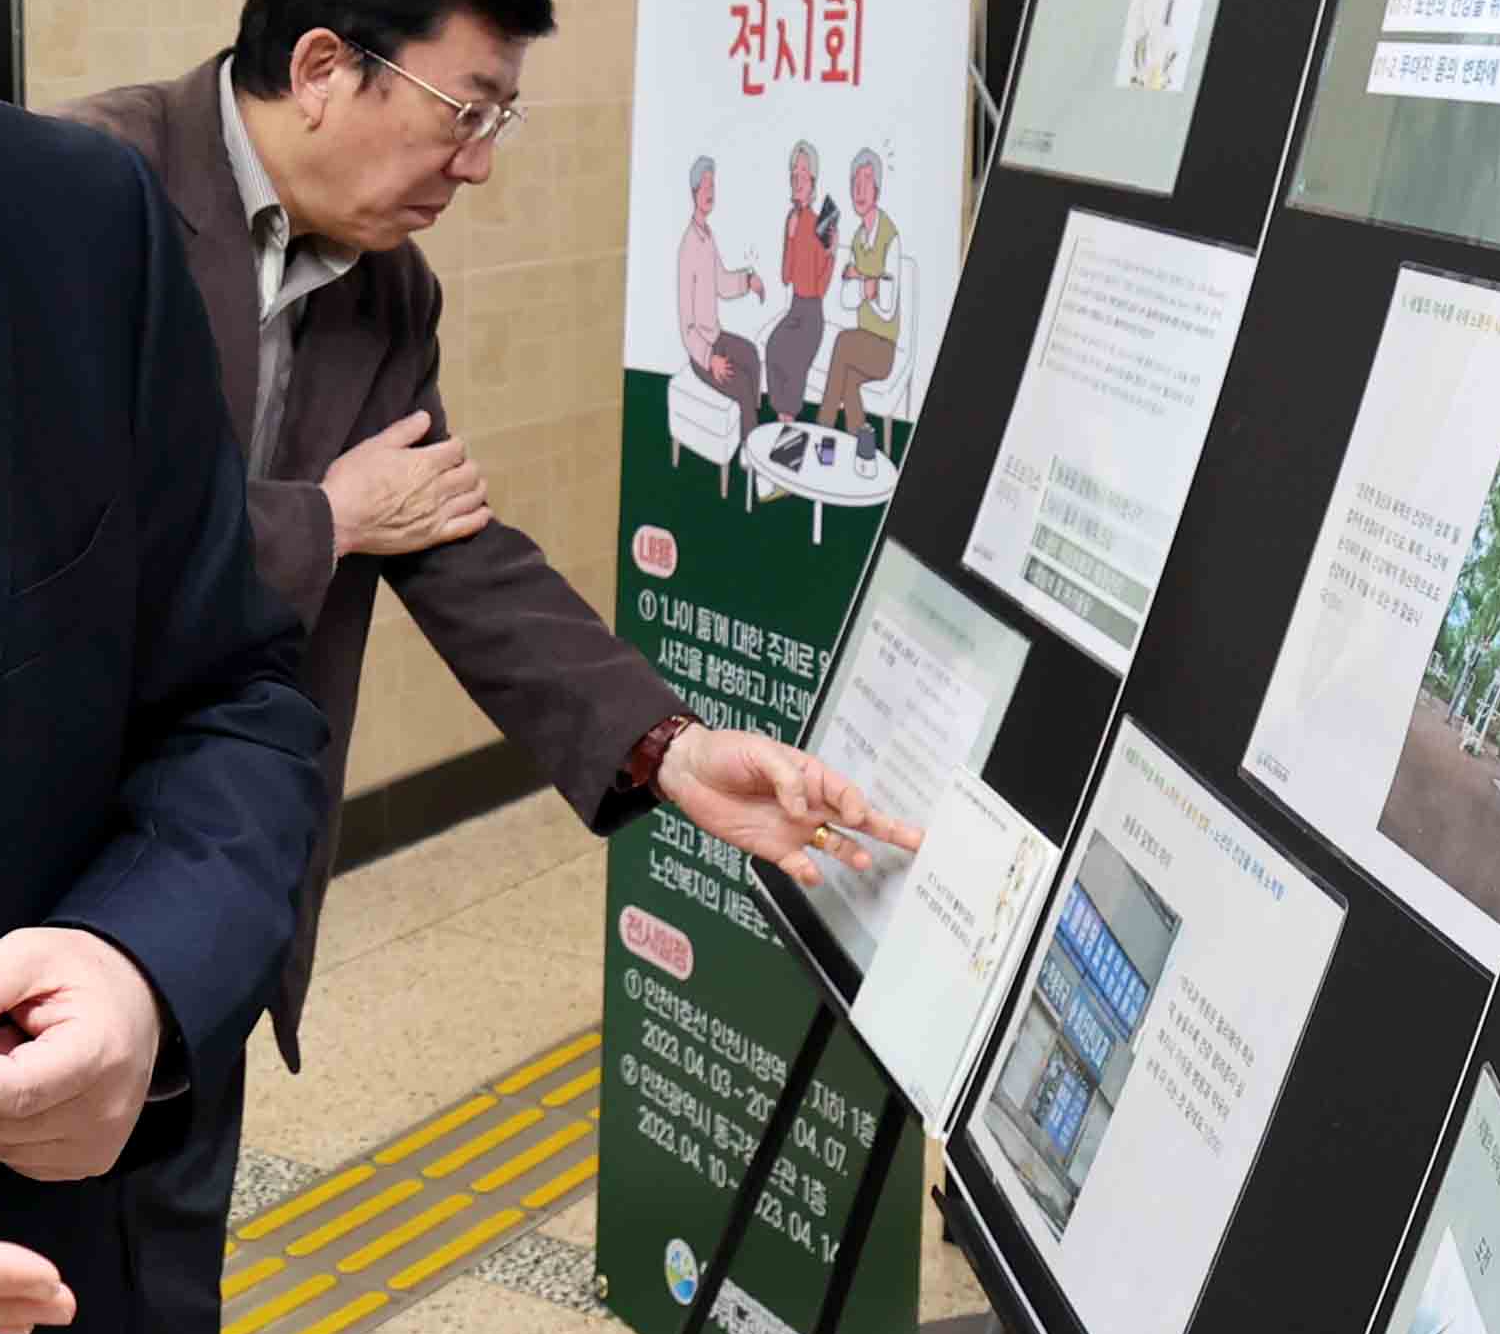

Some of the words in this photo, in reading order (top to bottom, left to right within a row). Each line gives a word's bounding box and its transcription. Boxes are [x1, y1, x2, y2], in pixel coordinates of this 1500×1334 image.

[1462, 57, 1499, 87] 변화에
[658, 636, 704, 682] 사진을
[705, 652, 767, 706] 촬영하고
[732, 620, 764, 661] 대한
[766, 631, 815, 679] 주제로
[652, 807, 695, 854] 그리고
[697, 830, 743, 881] 계획을
[649, 848, 720, 912] 노인복지의
[643, 976, 708, 1044] 인천1호선
[809, 1079, 846, 1130] 지하
[710, 1062, 732, 1098] 03
[639, 1064, 712, 1137] 인천광역시
[801, 1174, 828, 1217] 1층
[708, 1154, 728, 1188] 10
